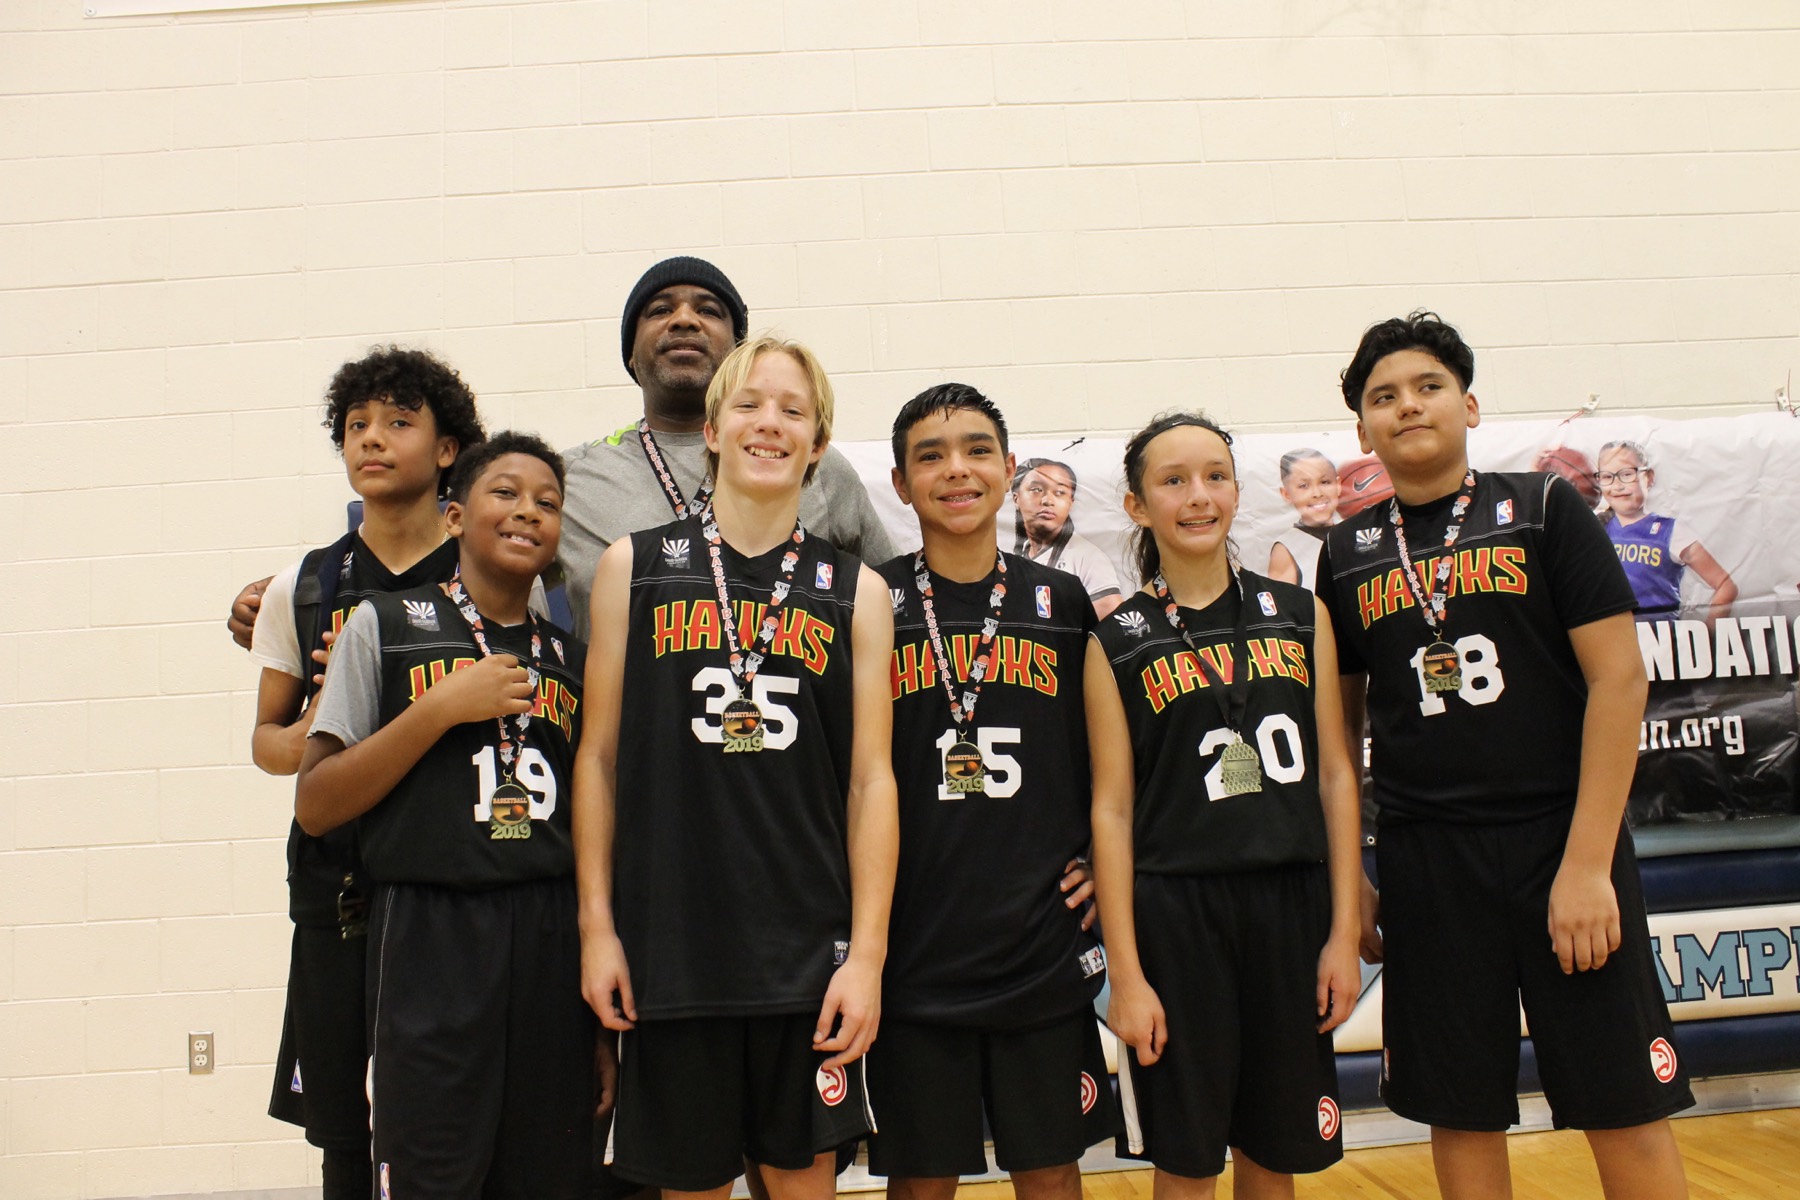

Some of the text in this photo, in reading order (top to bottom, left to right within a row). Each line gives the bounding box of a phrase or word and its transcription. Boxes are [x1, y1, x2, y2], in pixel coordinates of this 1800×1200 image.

[709, 546, 740, 652] BASKETBALL
[922, 599, 957, 701] BASKETBALL
[1409, 633, 1506, 717] 18
[1426, 676, 1463, 694] 2019
[1635, 615, 1800, 682] NDATI
[691, 666, 800, 751] 35
[723, 737, 765, 753] 2019
[472, 745, 557, 822] 19
[936, 726, 1023, 801] 15
[946, 777, 985, 794] 2019
[1198, 713, 1306, 802] 20
[491, 823, 532, 839] 2019
